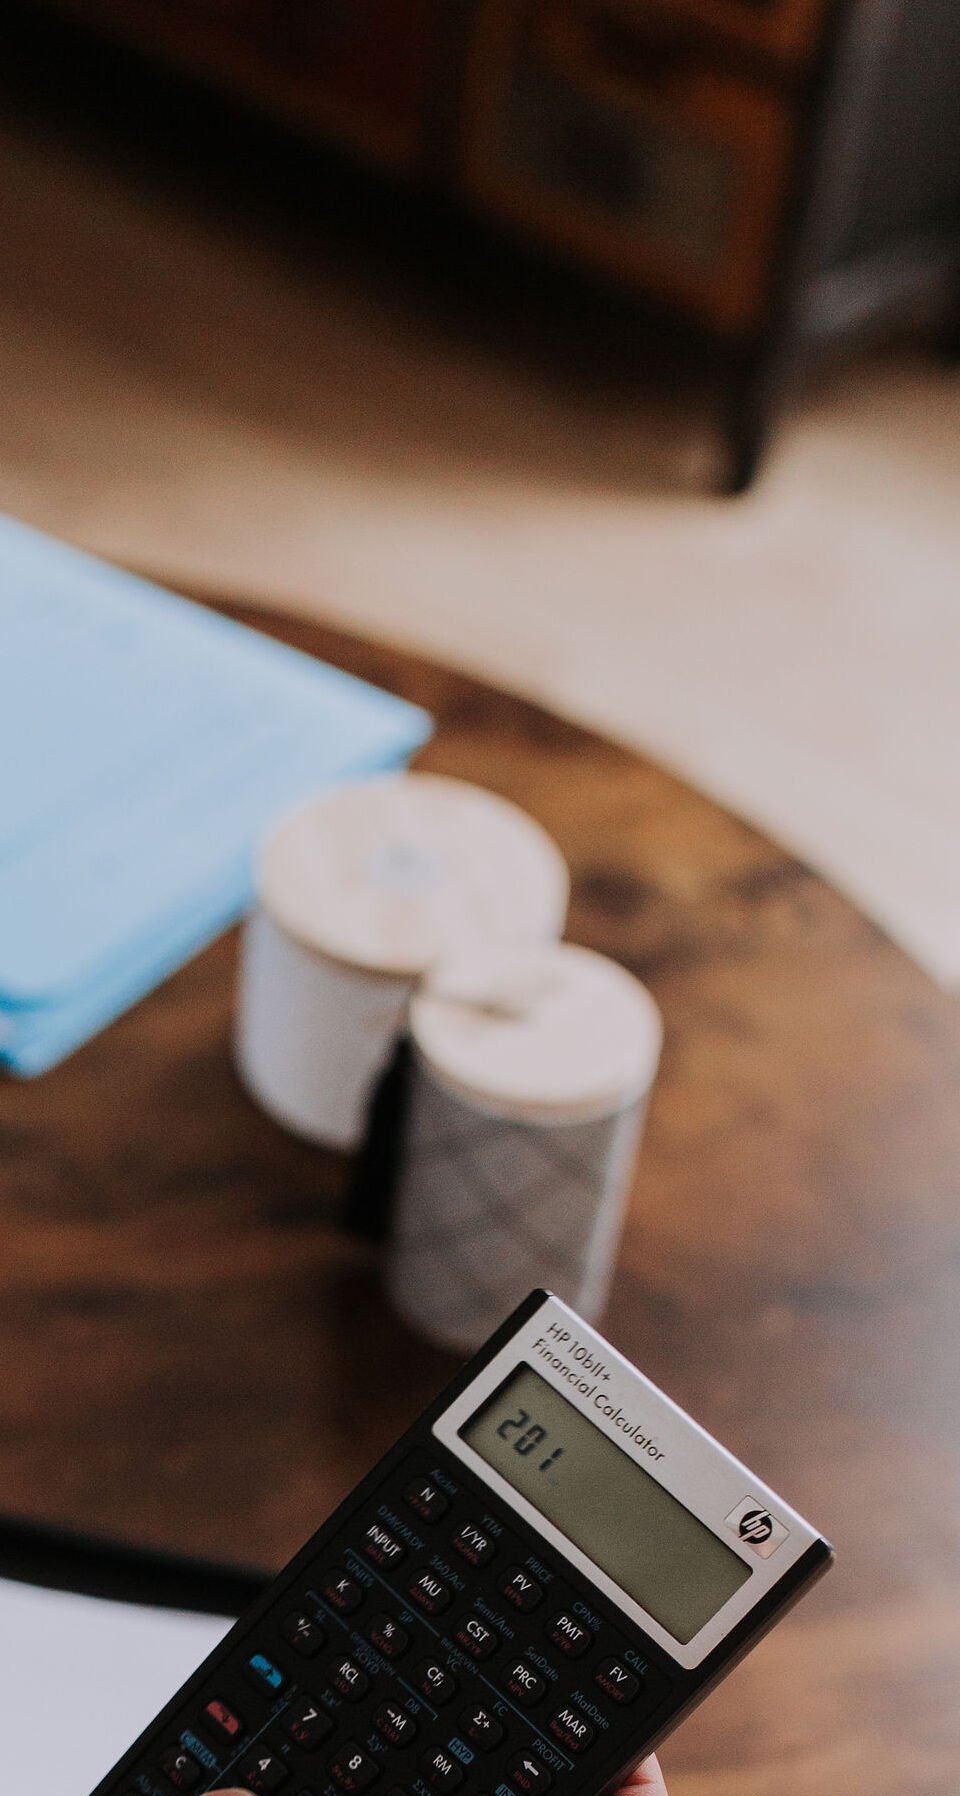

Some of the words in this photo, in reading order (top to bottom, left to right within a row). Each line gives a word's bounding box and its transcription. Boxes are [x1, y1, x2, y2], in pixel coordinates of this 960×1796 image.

[546, 1322, 572, 1344] HP
[531, 1338, 598, 1398] Financial
[593, 1393, 665, 1462] Calculator
[419, 1487, 436, 1502] N
[481, 1514, 504, 1537] YTM
[738, 1508, 772, 1545] hp
[365, 1524, 403, 1557] INPUT
[524, 1556, 553, 1585] PRICE
[336, 1578, 352, 1593] K
[418, 1575, 442, 1598] MU
[512, 1573, 533, 1592] PV
[466, 1619, 490, 1643] CST
[556, 1615, 584, 1641] PMT
[338, 1660, 361, 1686] RCL
[624, 1649, 650, 1675] CALL
[512, 1665, 538, 1690] PRC
[608, 1666, 629, 1684] FV
[301, 1706, 319, 1723] 7
[570, 1690, 611, 1730] MatDate
[558, 1709, 588, 1738] MAR
[174, 1754, 188, 1770] C
[257, 1756, 273, 1773] 4
[348, 1754, 364, 1771] 8
[432, 1754, 454, 1777] RM
[531, 1737, 567, 1771] PROFIT
